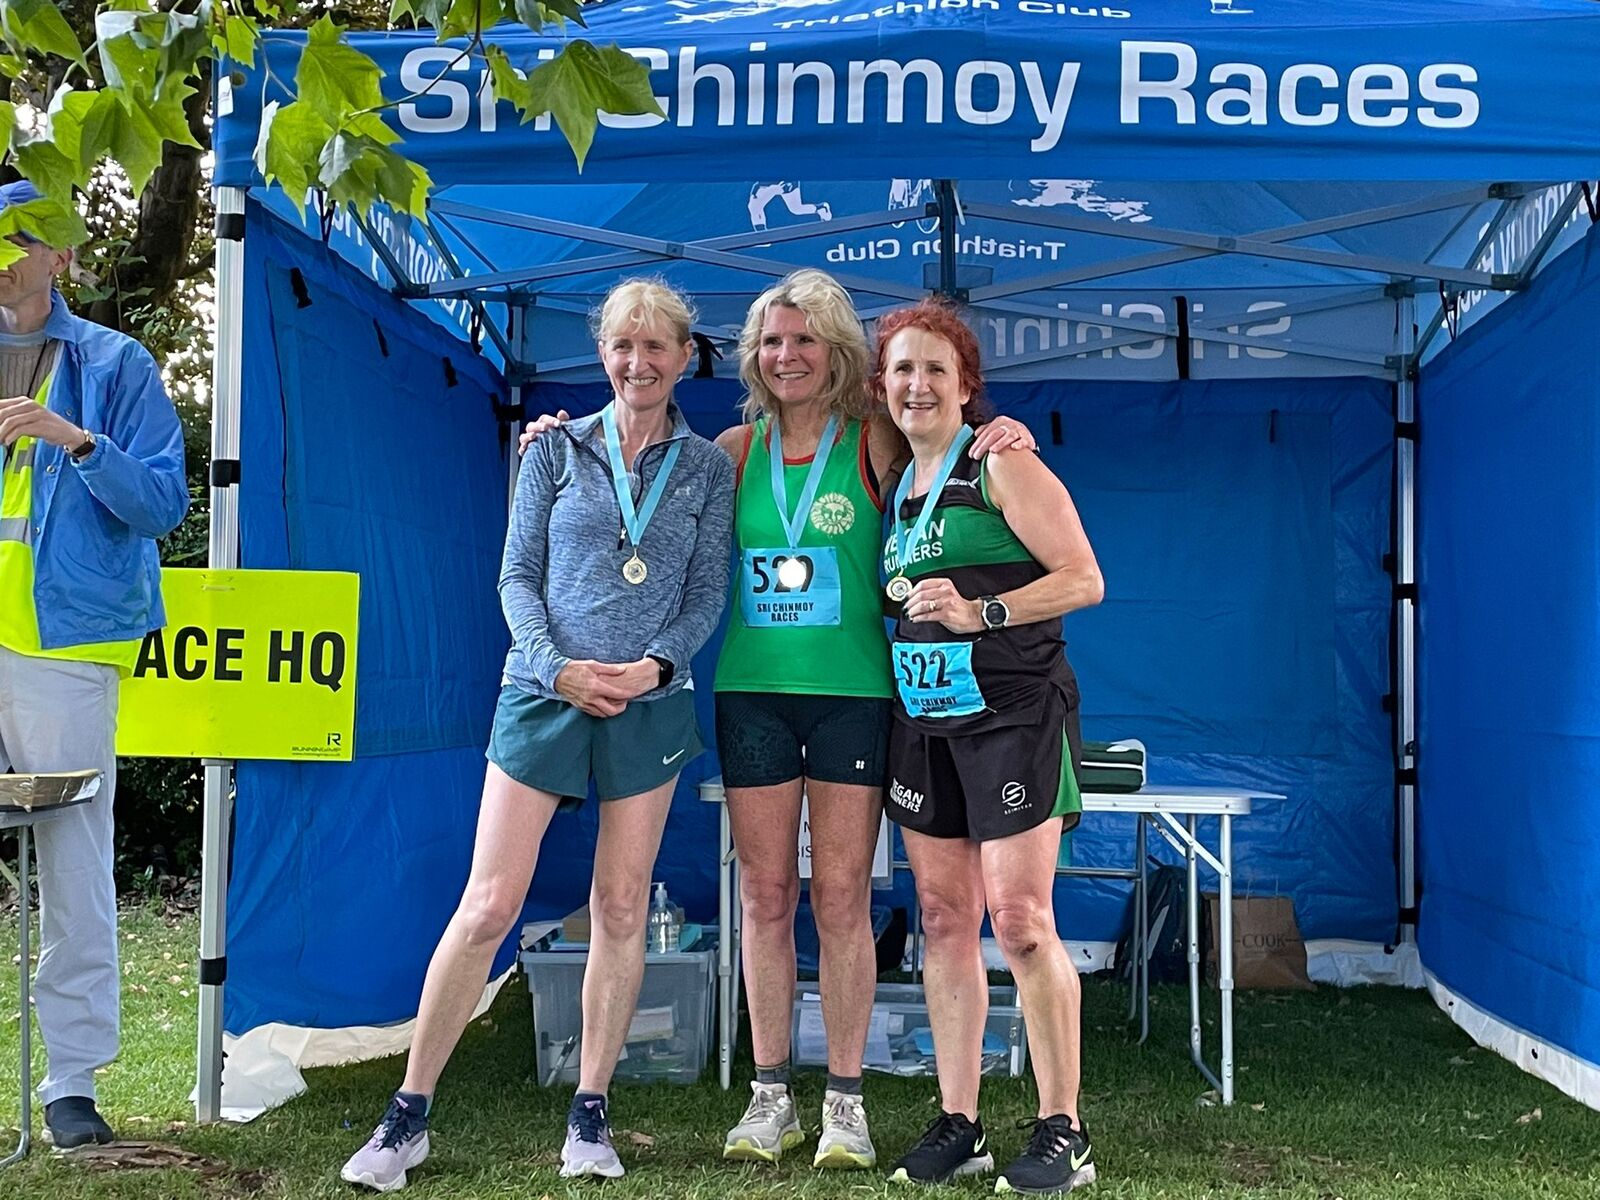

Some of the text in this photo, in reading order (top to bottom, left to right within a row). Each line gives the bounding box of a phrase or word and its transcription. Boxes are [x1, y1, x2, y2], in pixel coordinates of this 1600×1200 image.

[1018, 1, 1131, 18] Club
[1119, 40, 1480, 128] Races
[757, 602, 814, 613] SRI CHINMOY
[771, 612, 799, 622] RACES
[133, 626, 345, 693] ACE HQ
[900, 650, 952, 689] 522
[1242, 934, 1286, 948] COOK
